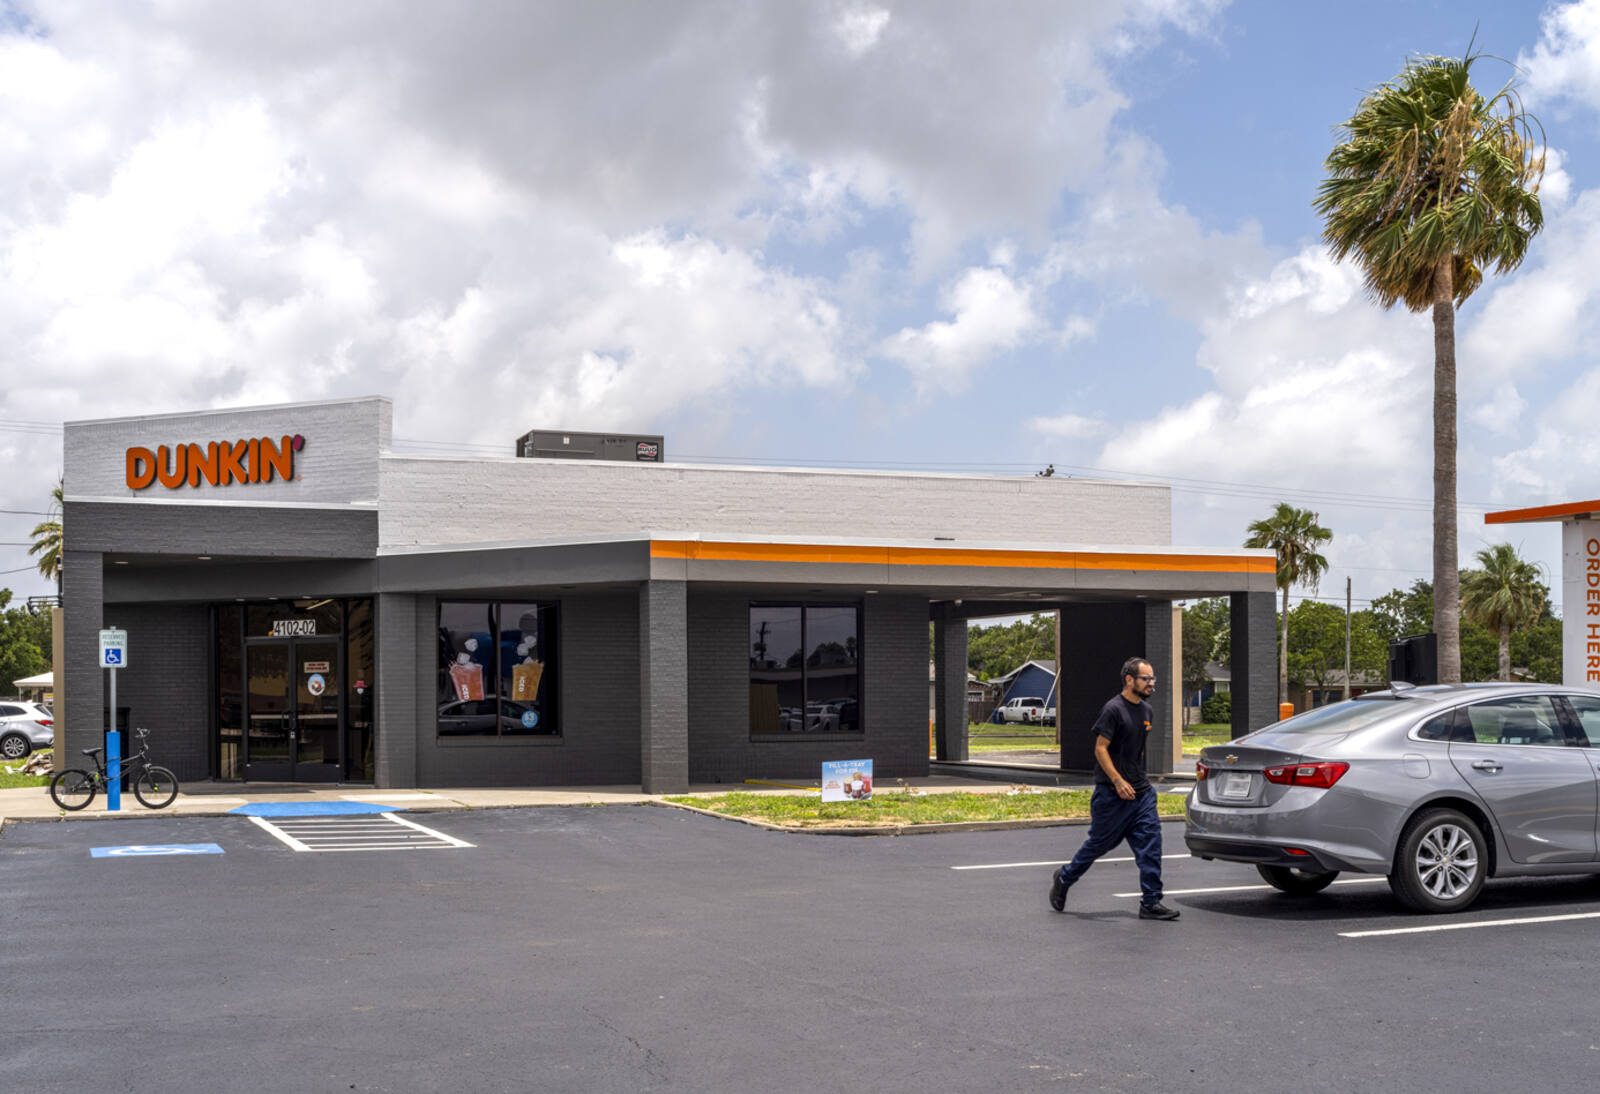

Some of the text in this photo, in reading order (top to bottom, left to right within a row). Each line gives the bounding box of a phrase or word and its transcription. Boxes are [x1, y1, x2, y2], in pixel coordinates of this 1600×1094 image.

[126, 434, 305, 489] DUNKIN'
[274, 620, 315, 636] 4102-02
[1586, 538, 1600, 682] ORDER HERE
